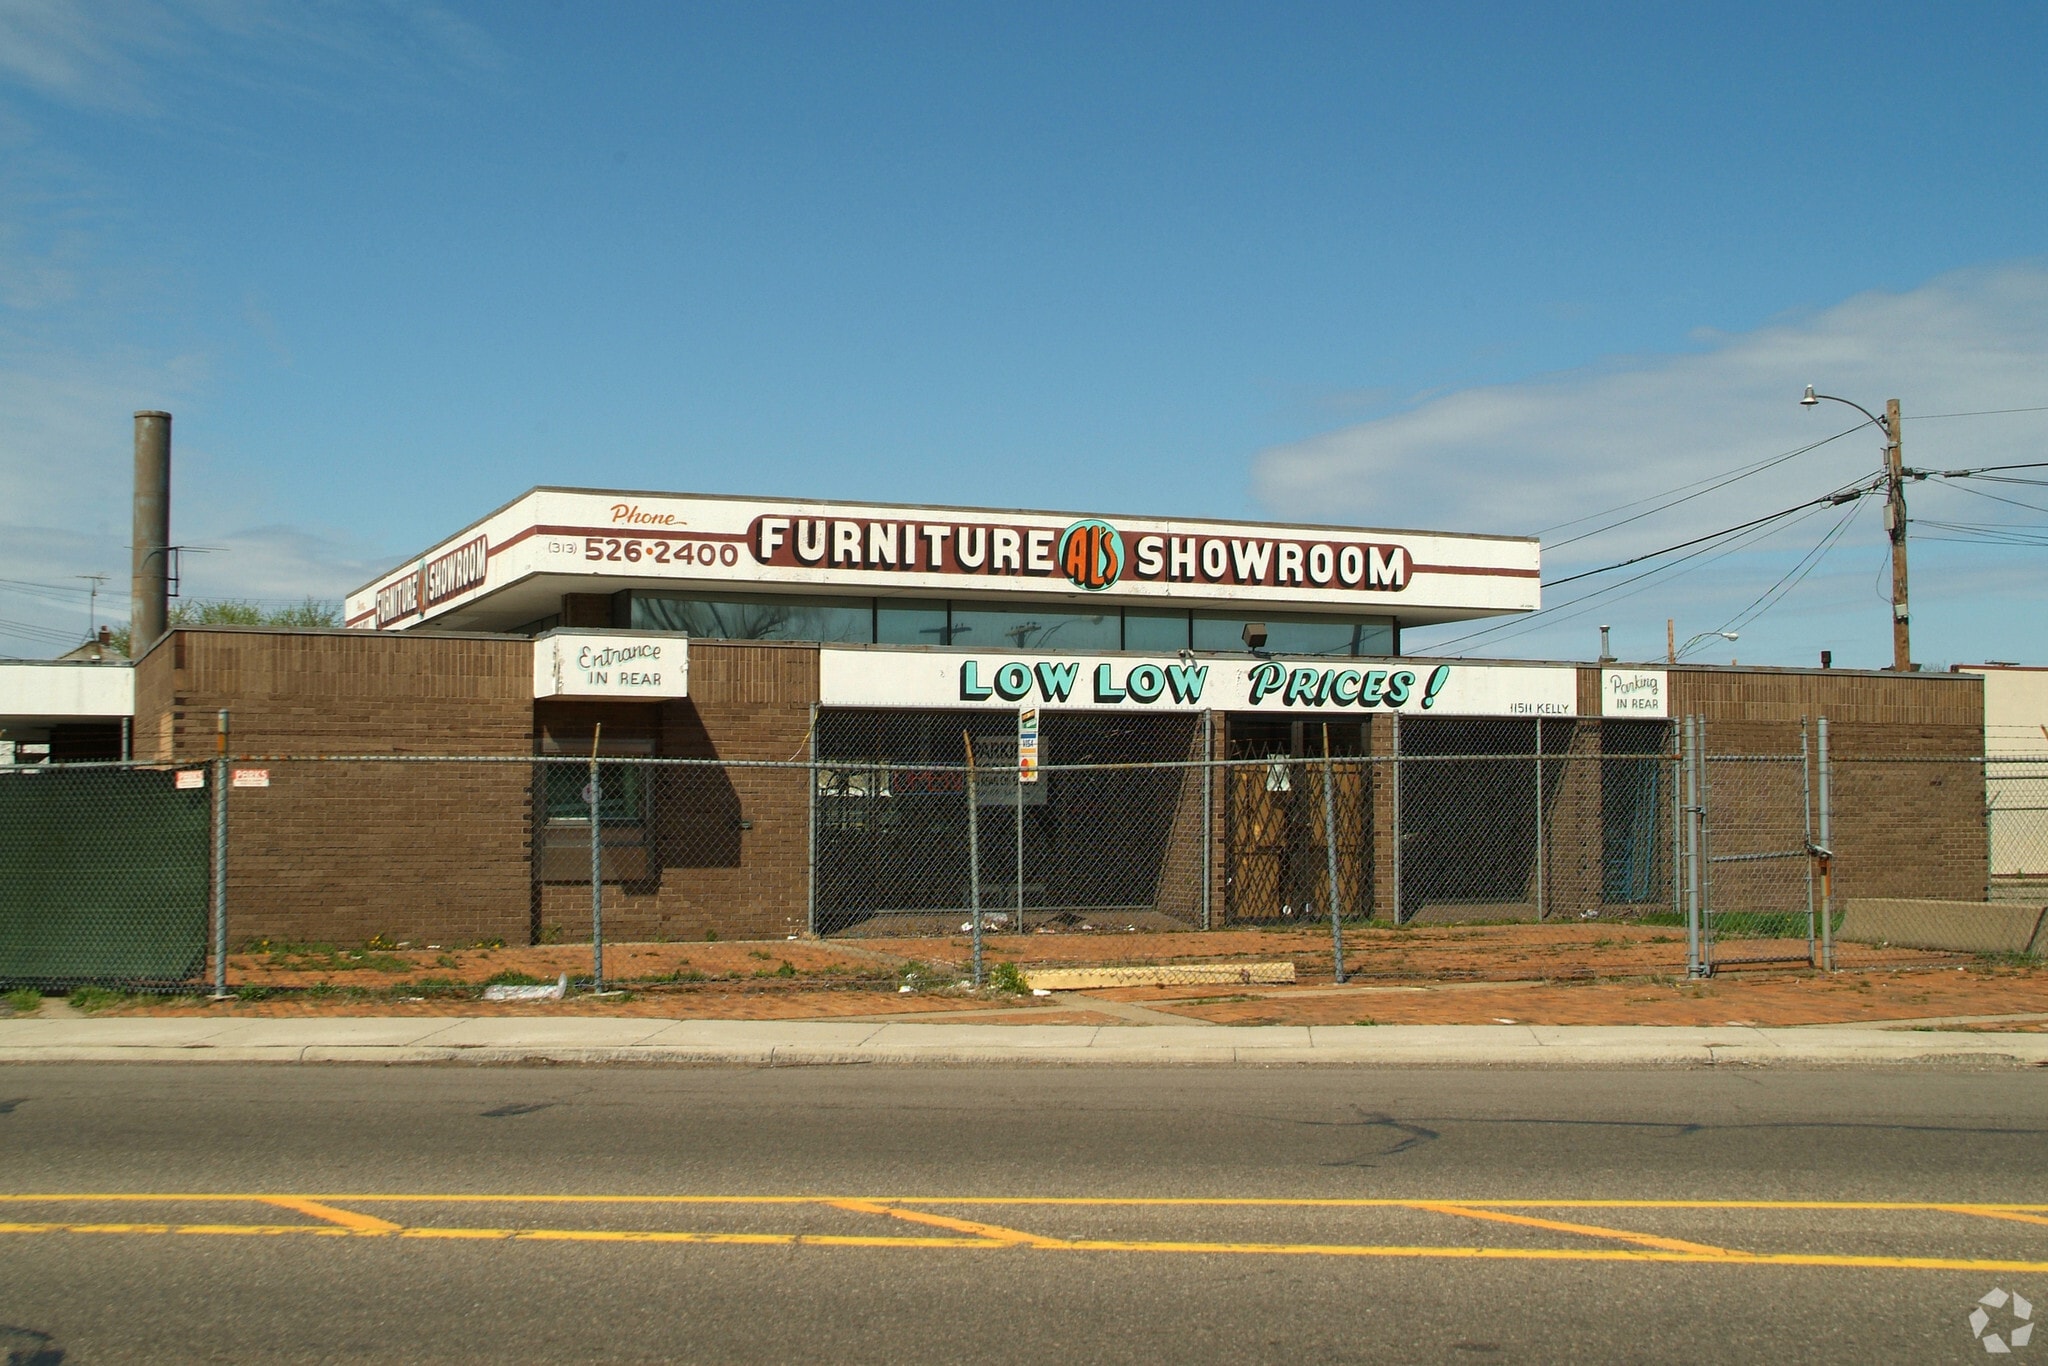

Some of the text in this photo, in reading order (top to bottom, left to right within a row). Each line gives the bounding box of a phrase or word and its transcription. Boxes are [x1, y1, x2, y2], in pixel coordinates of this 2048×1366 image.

[610, 504, 687, 526] Phone
[548, 541, 577, 555] (313)
[758, 517, 1056, 573] FURNITURE
[1136, 535, 1405, 588] SHOWROOM
[429, 537, 486, 600] SHOWROOM
[578, 645, 661, 669] Entrance
[589, 672, 662, 685] IN REAR
[960, 661, 1080, 703] LOW
[1094, 663, 1209, 704] LOW
[1610, 674, 1659, 695] Parking
[1510, 703, 1569, 714] 11511 KELLY
[1616, 699, 1659, 709] IN REAR
[236, 770, 267, 779] PARKS
